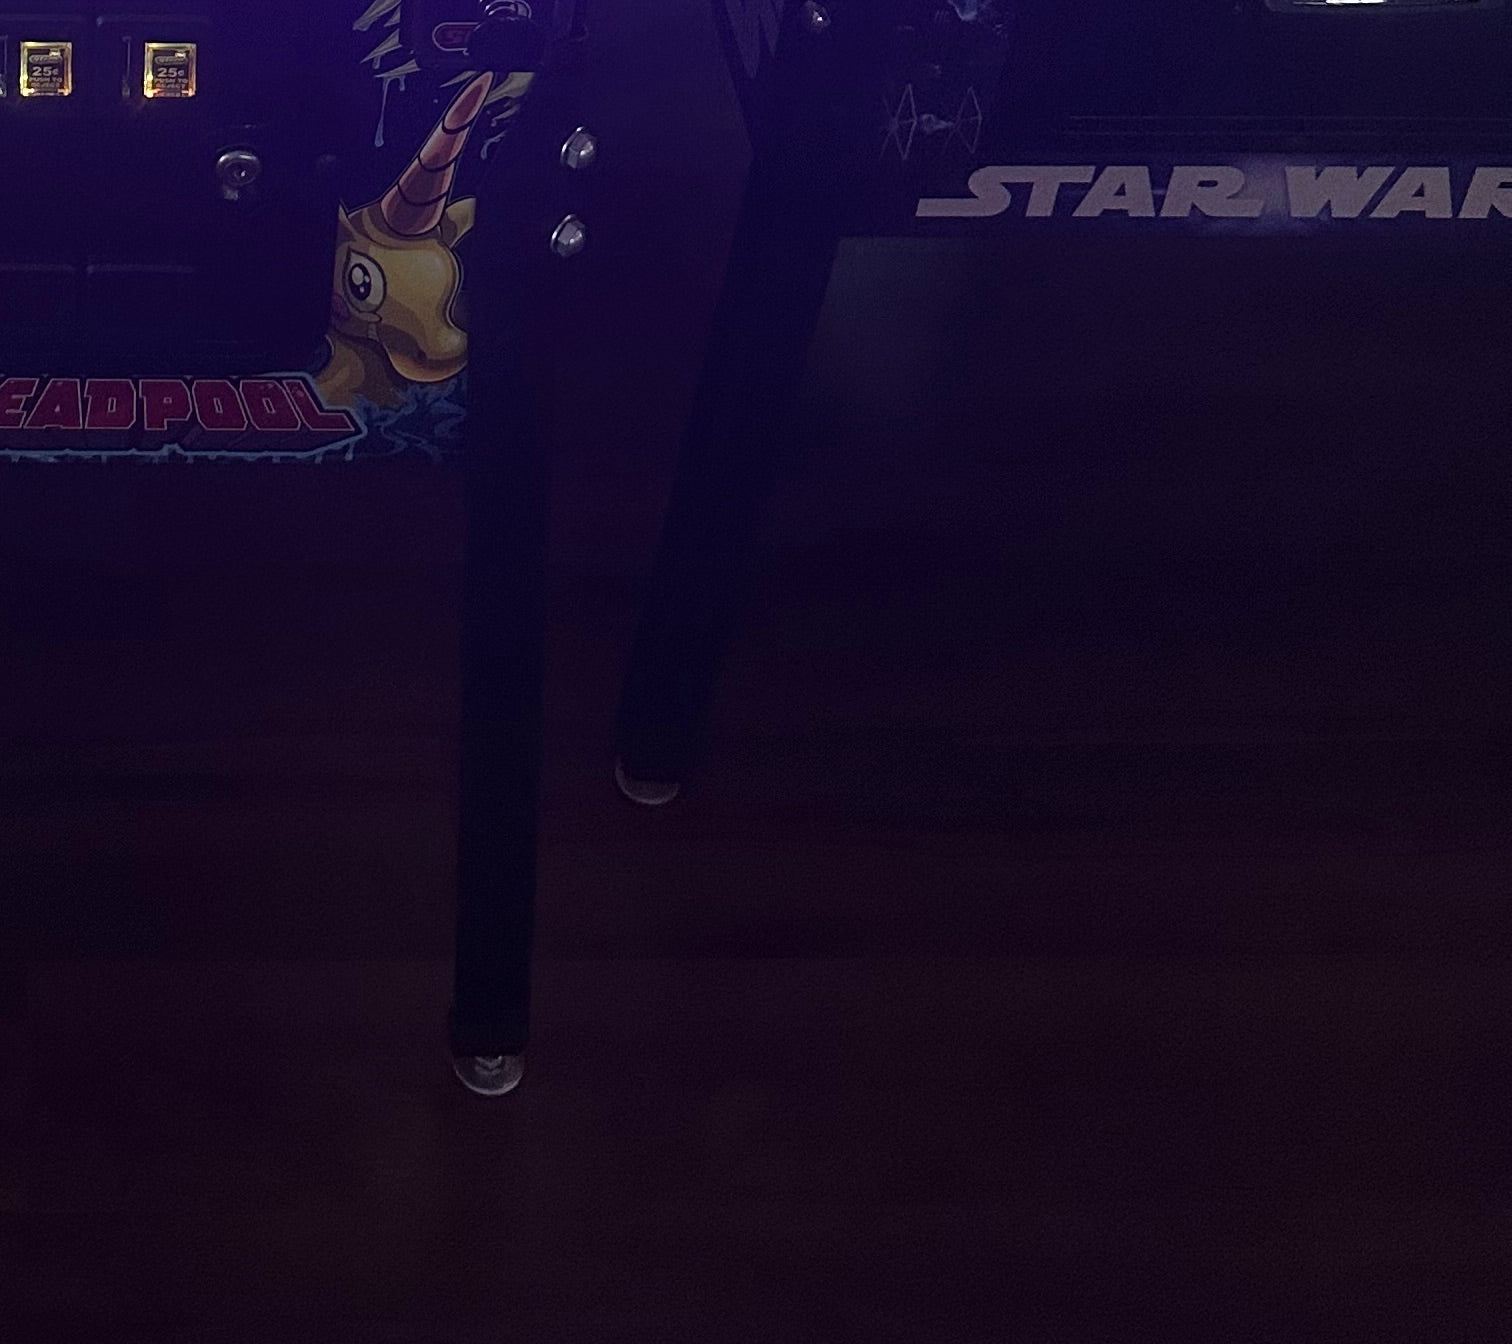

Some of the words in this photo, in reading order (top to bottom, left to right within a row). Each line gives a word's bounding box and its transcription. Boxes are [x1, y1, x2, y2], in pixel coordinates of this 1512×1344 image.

[31, 66, 58, 76] 25¢
[157, 67, 185, 78] 25¢
[916, 165, 1266, 218] STAR
